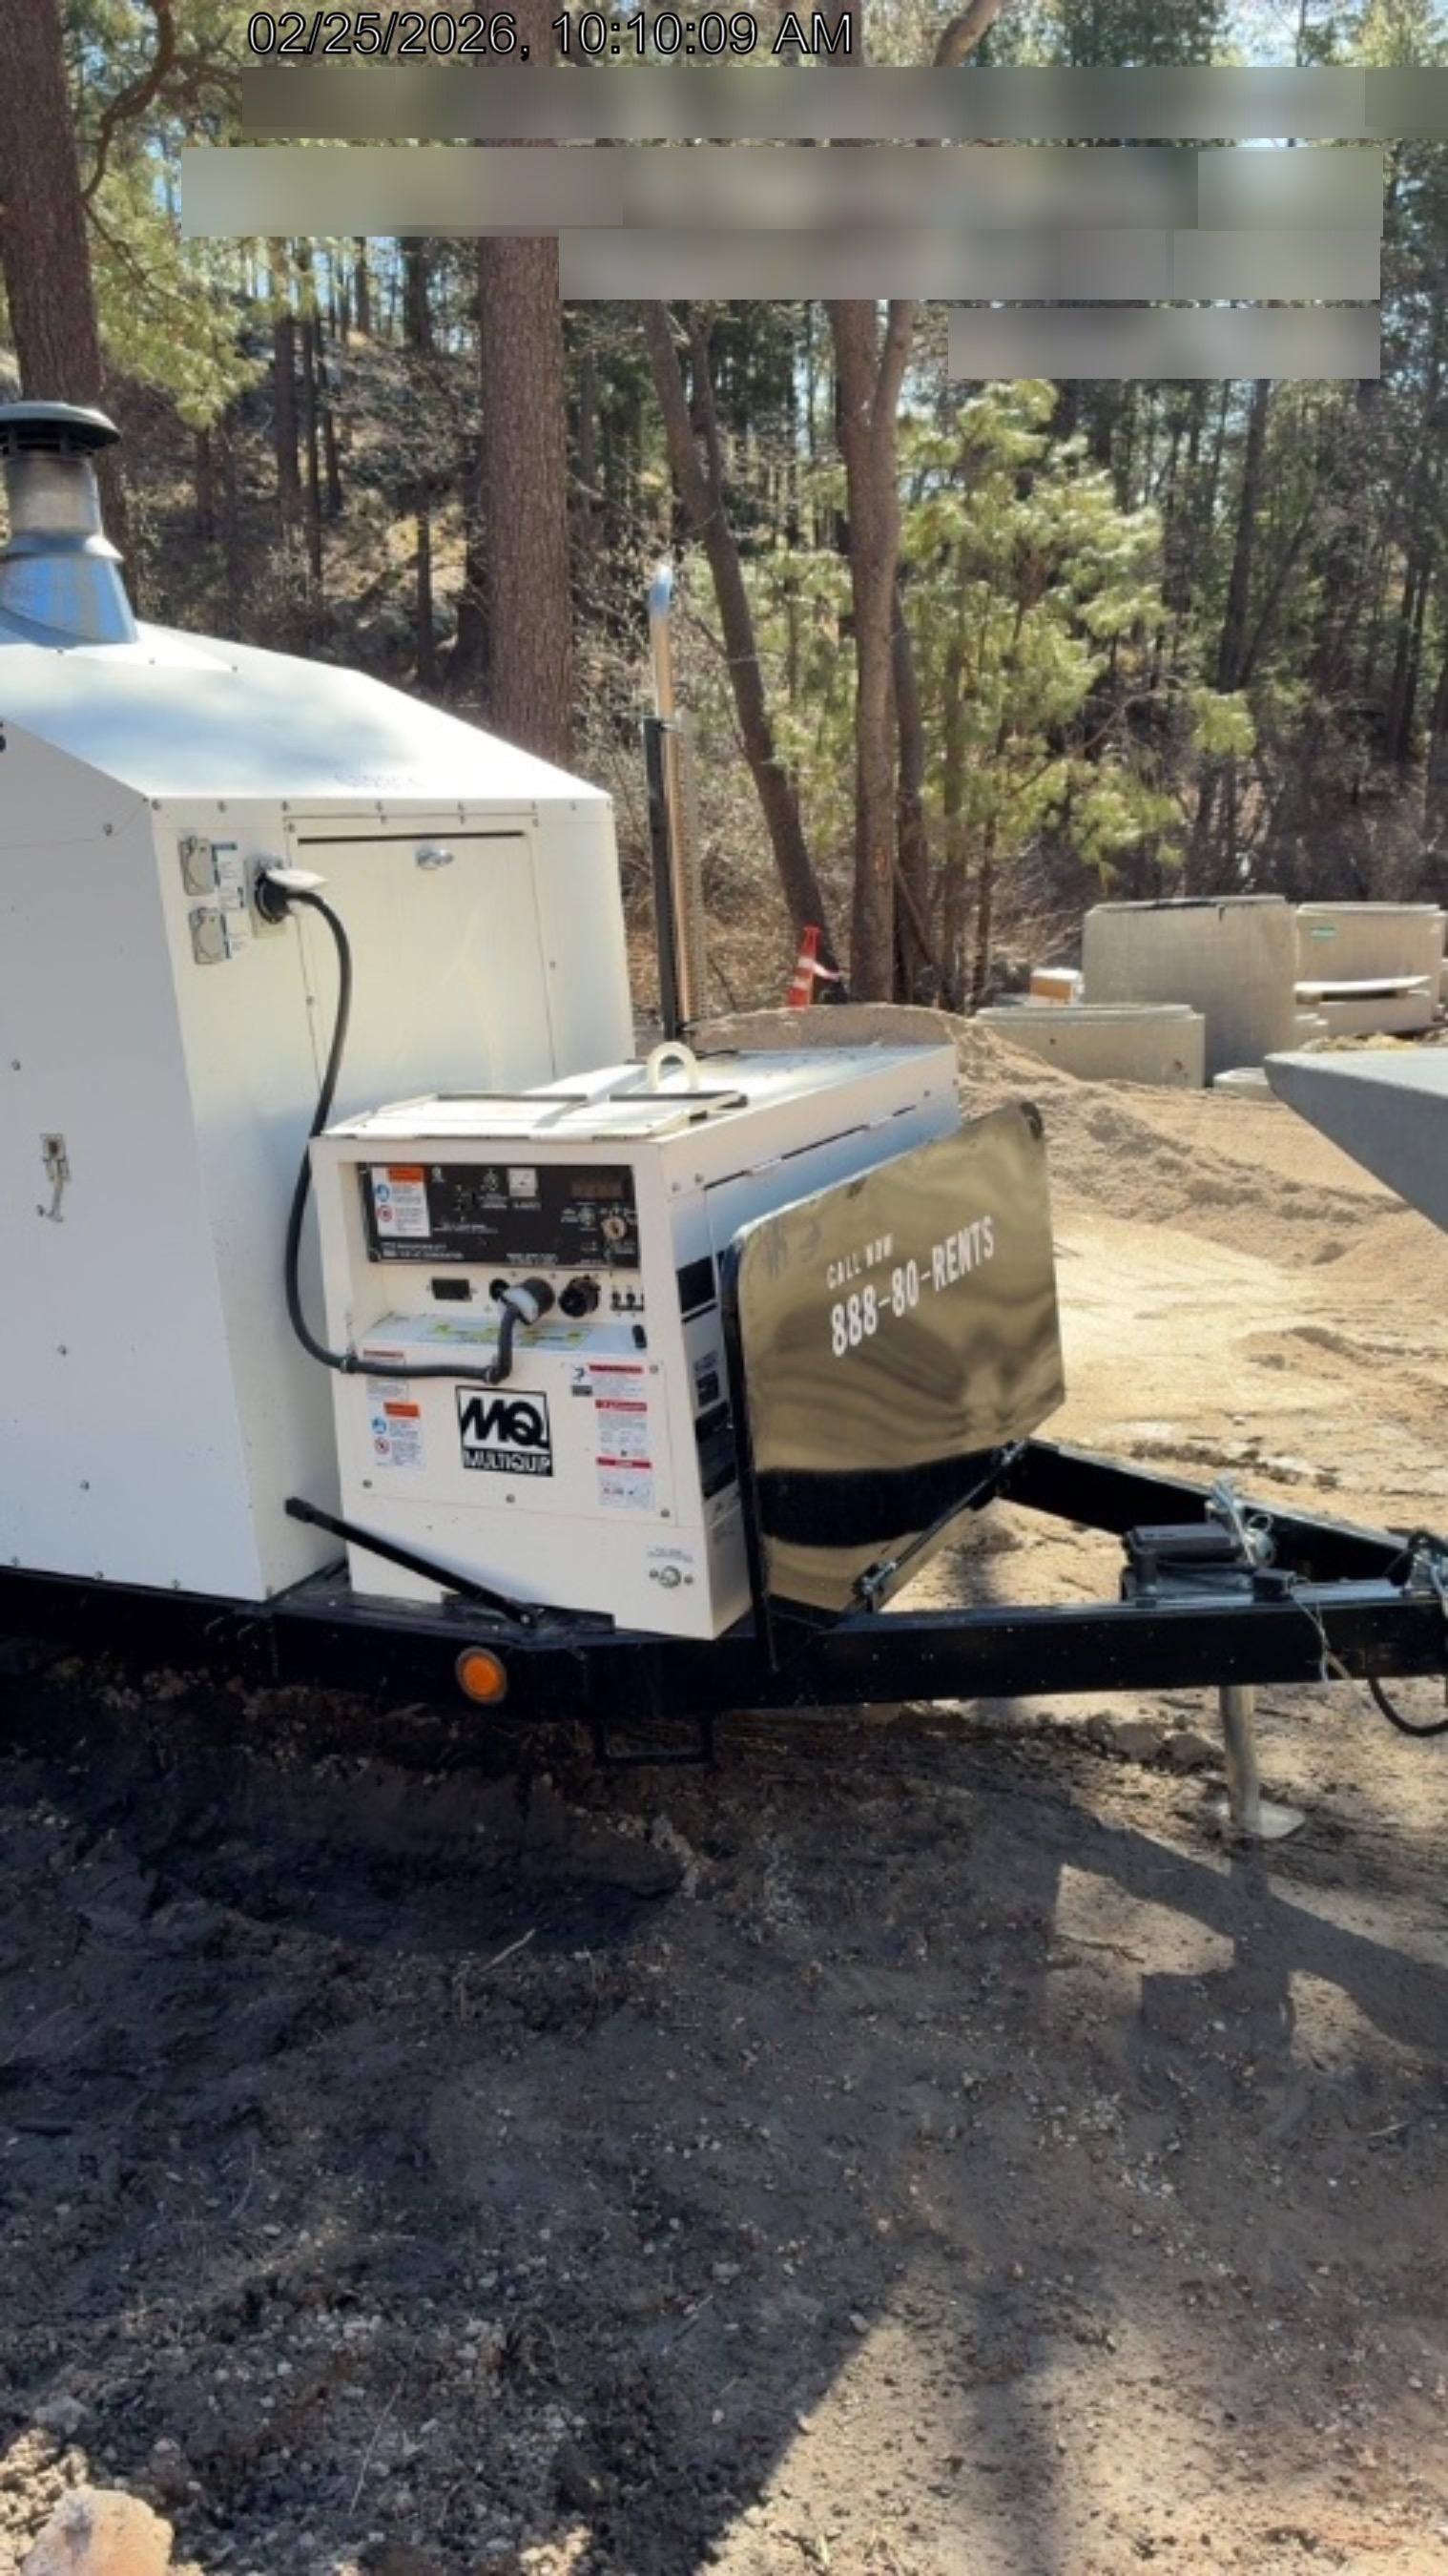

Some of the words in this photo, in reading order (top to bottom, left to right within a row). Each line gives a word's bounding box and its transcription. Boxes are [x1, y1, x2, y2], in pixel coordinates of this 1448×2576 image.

[826, 1253, 862, 1289] CALL
[865, 1233, 893, 1269] NOW
[831, 1215, 995, 1358] 888-80-RENTS
[461, 1397, 550, 1448] MQ
[463, 1448, 551, 1474] MULTIQUIP
